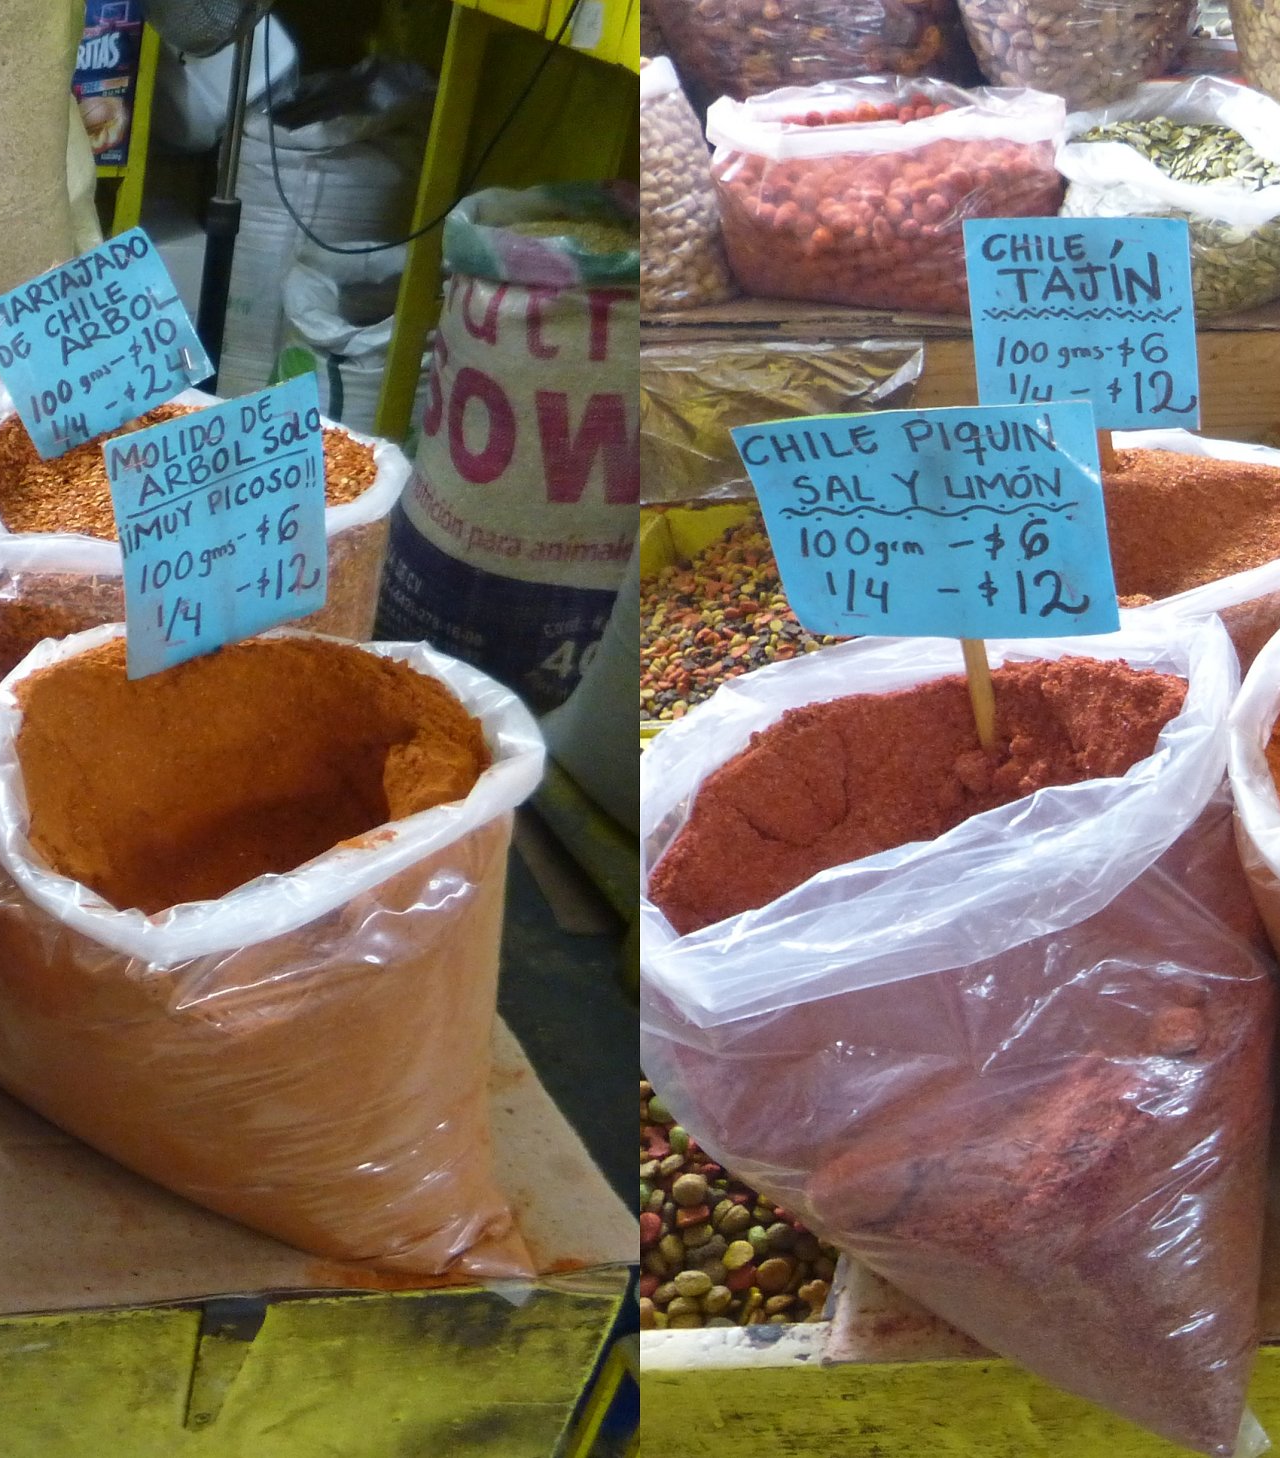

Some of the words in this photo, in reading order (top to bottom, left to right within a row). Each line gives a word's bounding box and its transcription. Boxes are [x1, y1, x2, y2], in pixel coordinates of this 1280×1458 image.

[981, 233, 1086, 262] CHILE
[997, 239, 1162, 304] TAJÍN
[44, 281, 128, 338] CHILE
[61, 287, 179, 366] ARBOL
[112, 416, 225, 481] MOLIDO
[241, 395, 272, 434] DE
[139, 441, 255, 506] ARBOL
[263, 407, 321, 454] SOLO
[740, 425, 879, 466] CHILE
[207, 456, 316, 515] PICOSO!!
[793, 475, 875, 505] SAL
[892, 470, 919, 505] Y
[944, 466, 1061, 500] LIMÓN
[157, 597, 202, 642] 1/4
[826, 569, 888, 613] 1/4
